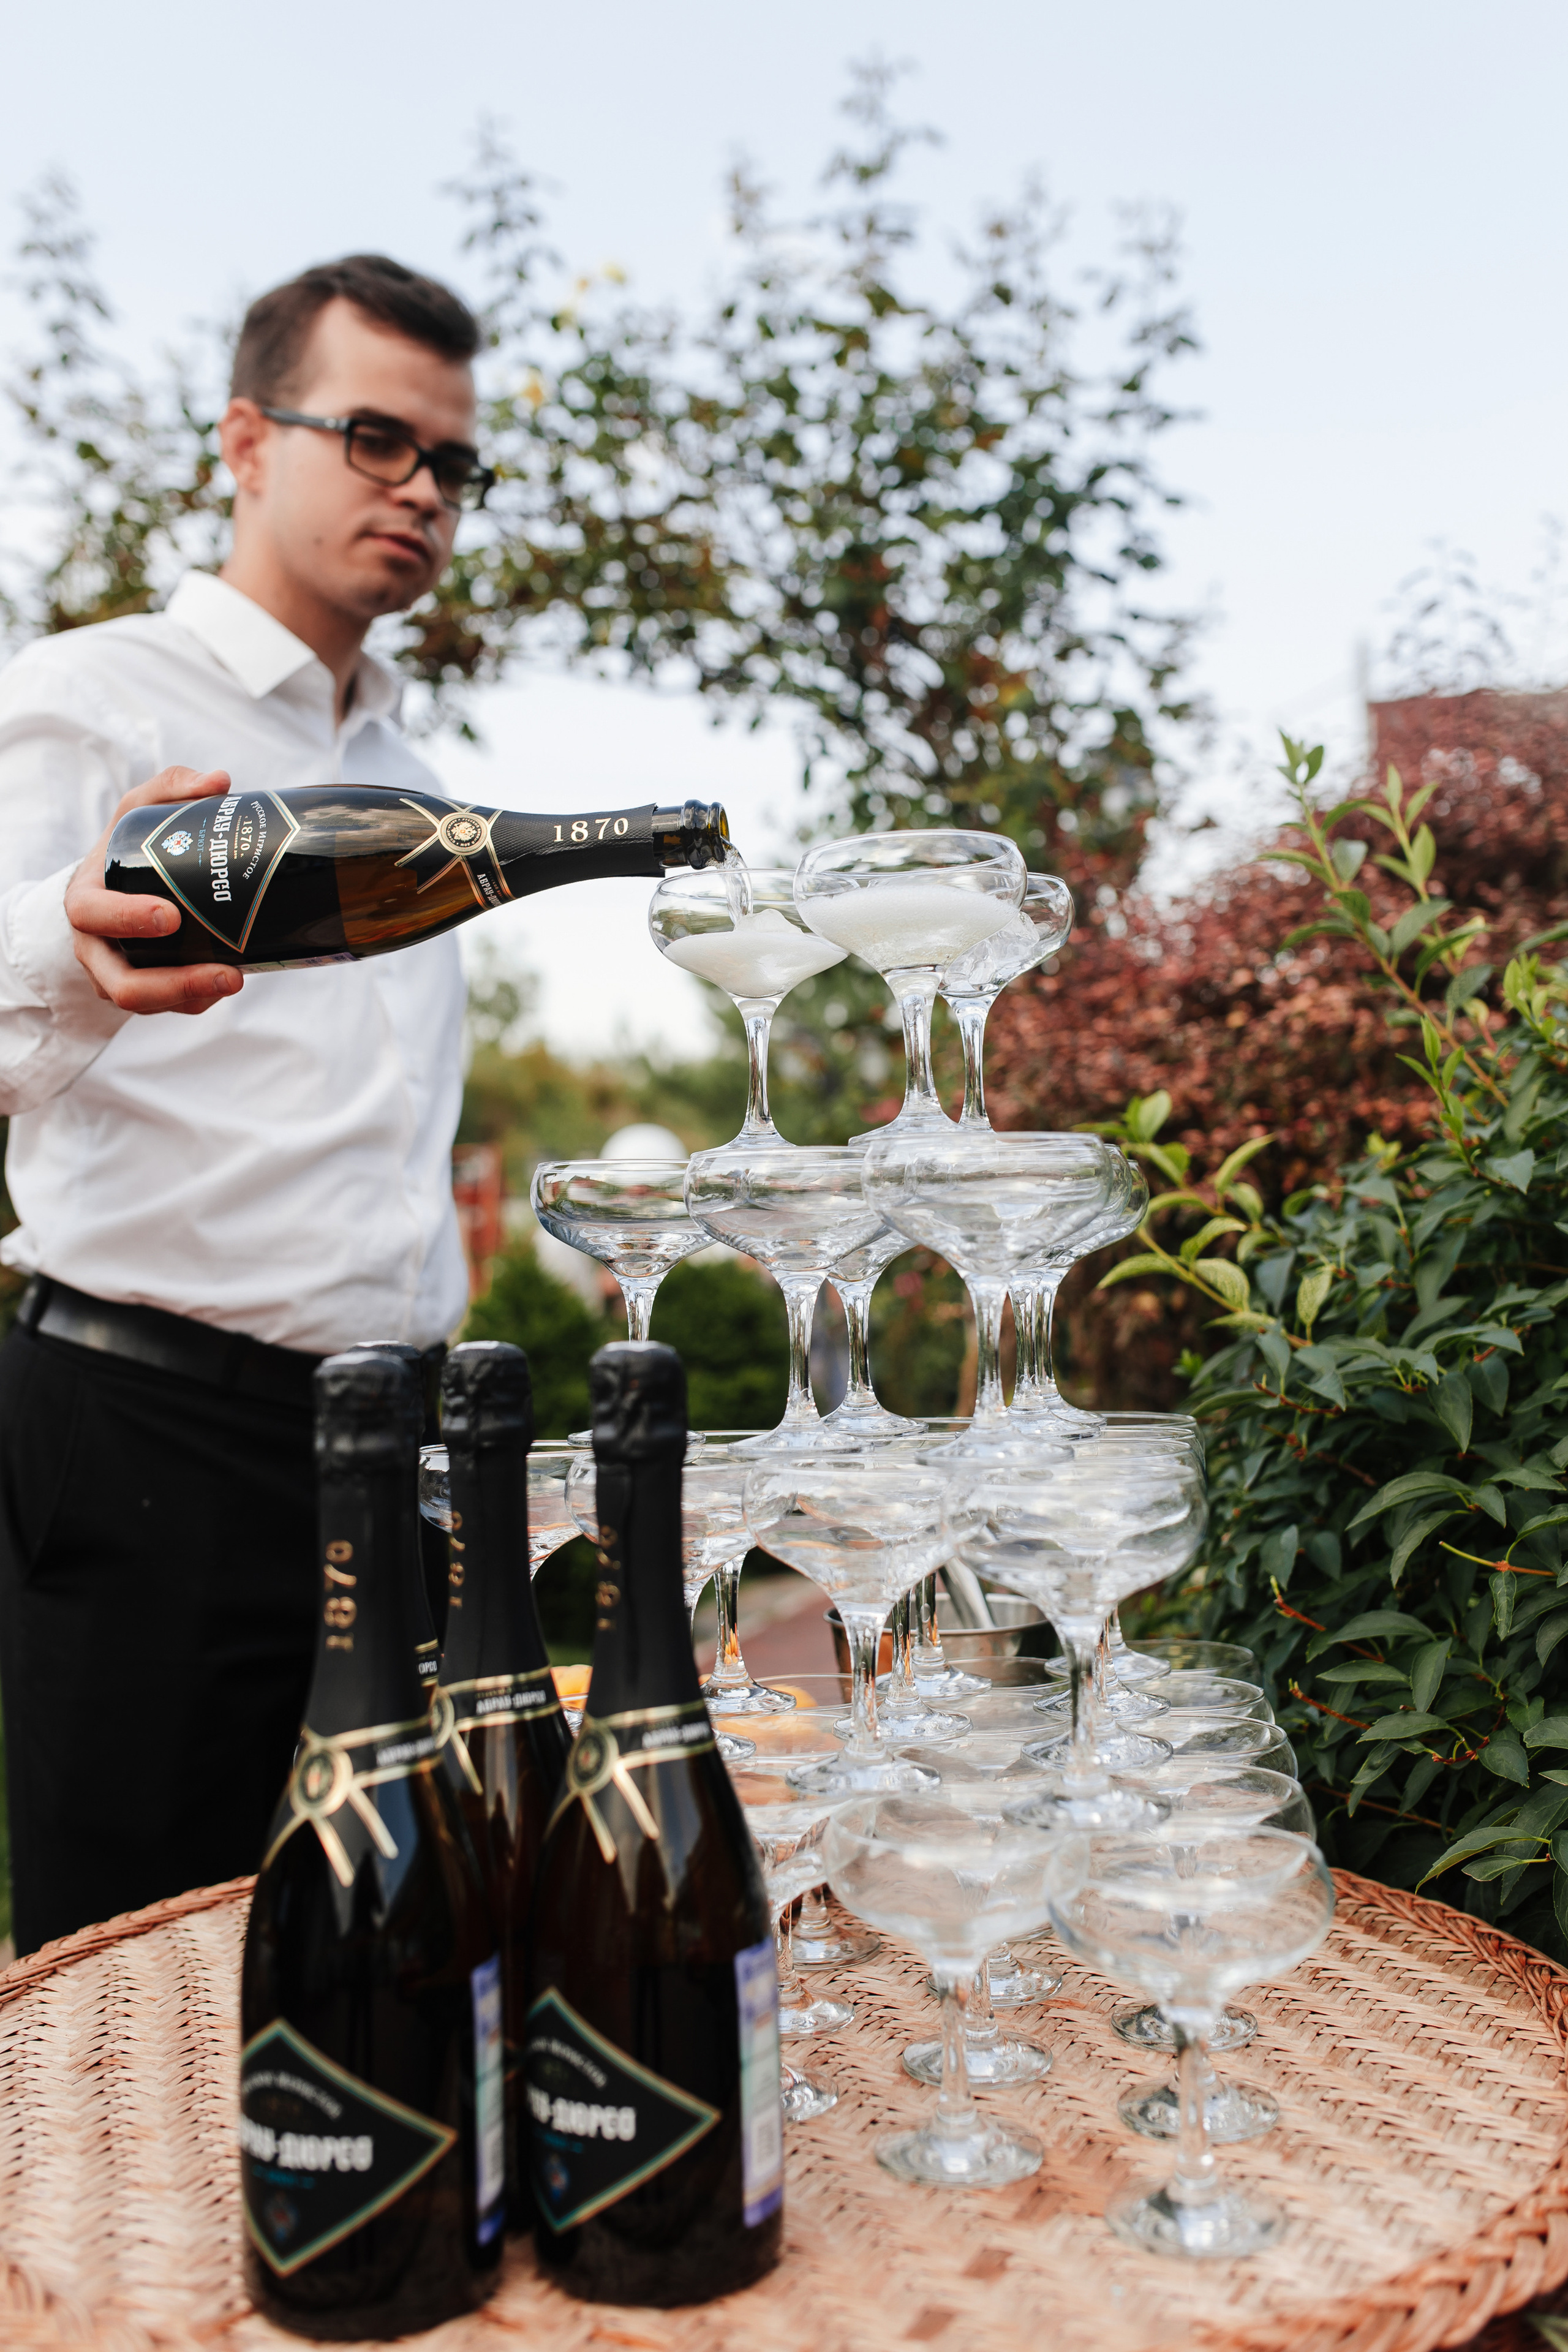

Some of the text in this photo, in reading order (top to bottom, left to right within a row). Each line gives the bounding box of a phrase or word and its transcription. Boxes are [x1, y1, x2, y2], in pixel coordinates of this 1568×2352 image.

[197, 829, 206, 852] БРЮТ
[240, 820, 253, 851] 1870
[243, 800, 267, 880] РУССКОЕ ИГРИСТОЕ
[554, 818, 628, 842] 1870
[323, 1539, 357, 1653] 1870
